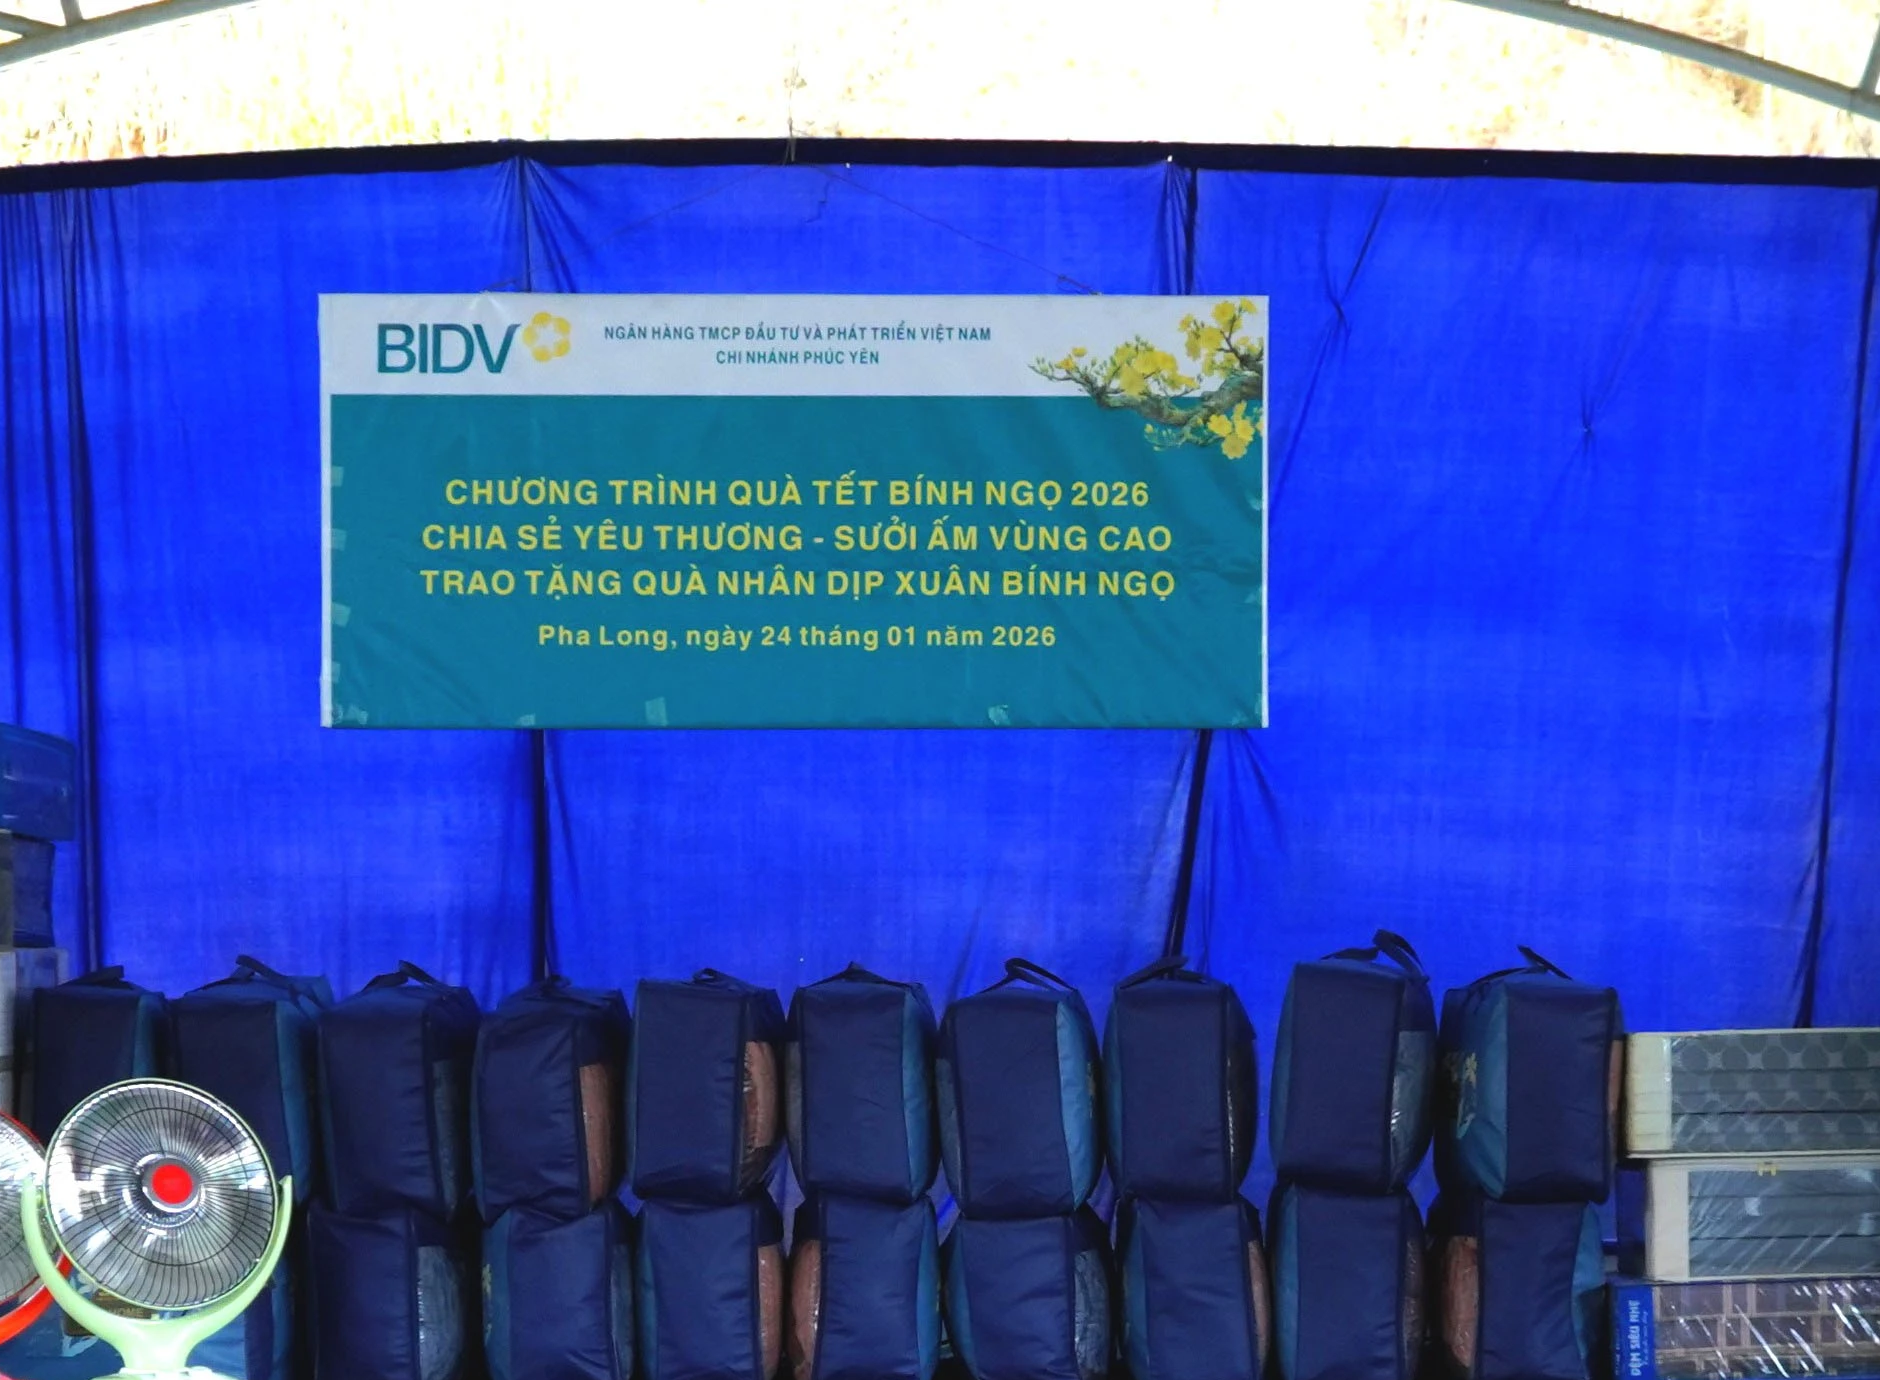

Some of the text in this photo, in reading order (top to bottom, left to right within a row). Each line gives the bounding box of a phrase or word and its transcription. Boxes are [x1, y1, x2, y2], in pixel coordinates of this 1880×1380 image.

[377, 323, 521, 374] BIDV
[604, 319, 992, 343] NGÂN HÀNG TMCP ĐẦU TƯ VÀ PHÁT TRIỂN VIỆT NAM
[715, 347, 880, 365] CHI NHÁNH PHÚC YÊN
[445, 470, 1149, 511] CHƯƠNG TRÌNH QUÀ TẾT BÍNH NGỌ 2026
[422, 524, 507, 550] CHIA
[517, 515, 562, 551] SẺ
[574, 518, 643, 551] YÊU
[653, 522, 802, 551] THƯƠNG
[834, 515, 917, 551] SƯỞI
[927, 515, 977, 551] ẤM
[989, 519, 1087, 551] VÙNG
[1099, 525, 1172, 552] CAO
[420, 564, 1175, 601] TRAO TẶNG QUÀ NHÂN DỊP XUÂN BÍNH NGỌ
[539, 625, 1056, 652] Pha Long, ngày 24 tháng 01 năm 2026
